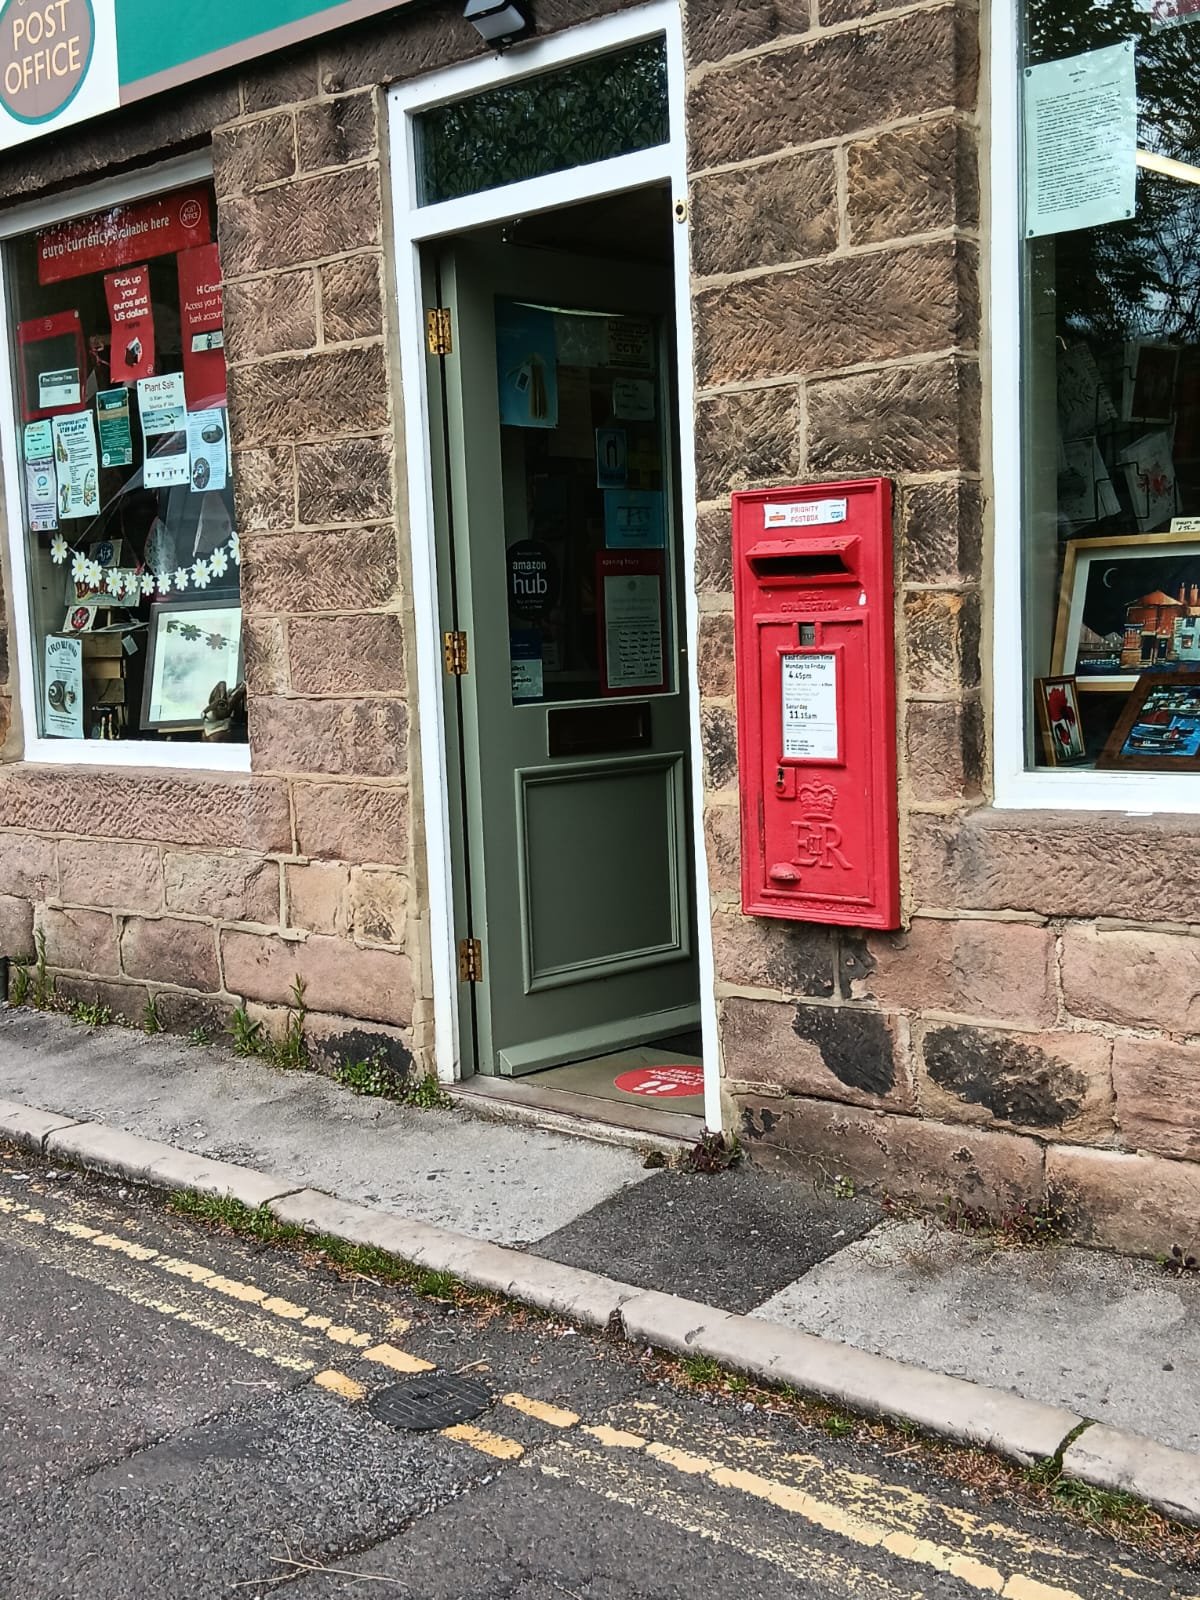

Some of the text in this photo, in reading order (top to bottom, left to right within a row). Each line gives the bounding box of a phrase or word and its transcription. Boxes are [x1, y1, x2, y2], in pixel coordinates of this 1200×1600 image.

[13, 0, 70, 51] POST
[5, 35, 81, 94] OFFICE
[42, 216, 170, 259] euro currency available here
[114, 275, 142, 288] Pick up
[121, 288, 138, 300] your
[196, 285, 203, 295] Hi
[113, 295, 148, 311] euros and
[185, 302, 203, 312] Access
[204, 298, 216, 310] your
[114, 307, 149, 322] US dollars
[189, 310, 223, 323] bank accoun
[144, 381, 175, 393] Plant Sale
[790, 505, 819, 513] PRIORITY
[790, 514, 819, 523] POSTBOX
[512, 560, 547, 570] amazon
[513, 572, 548, 594] hub
